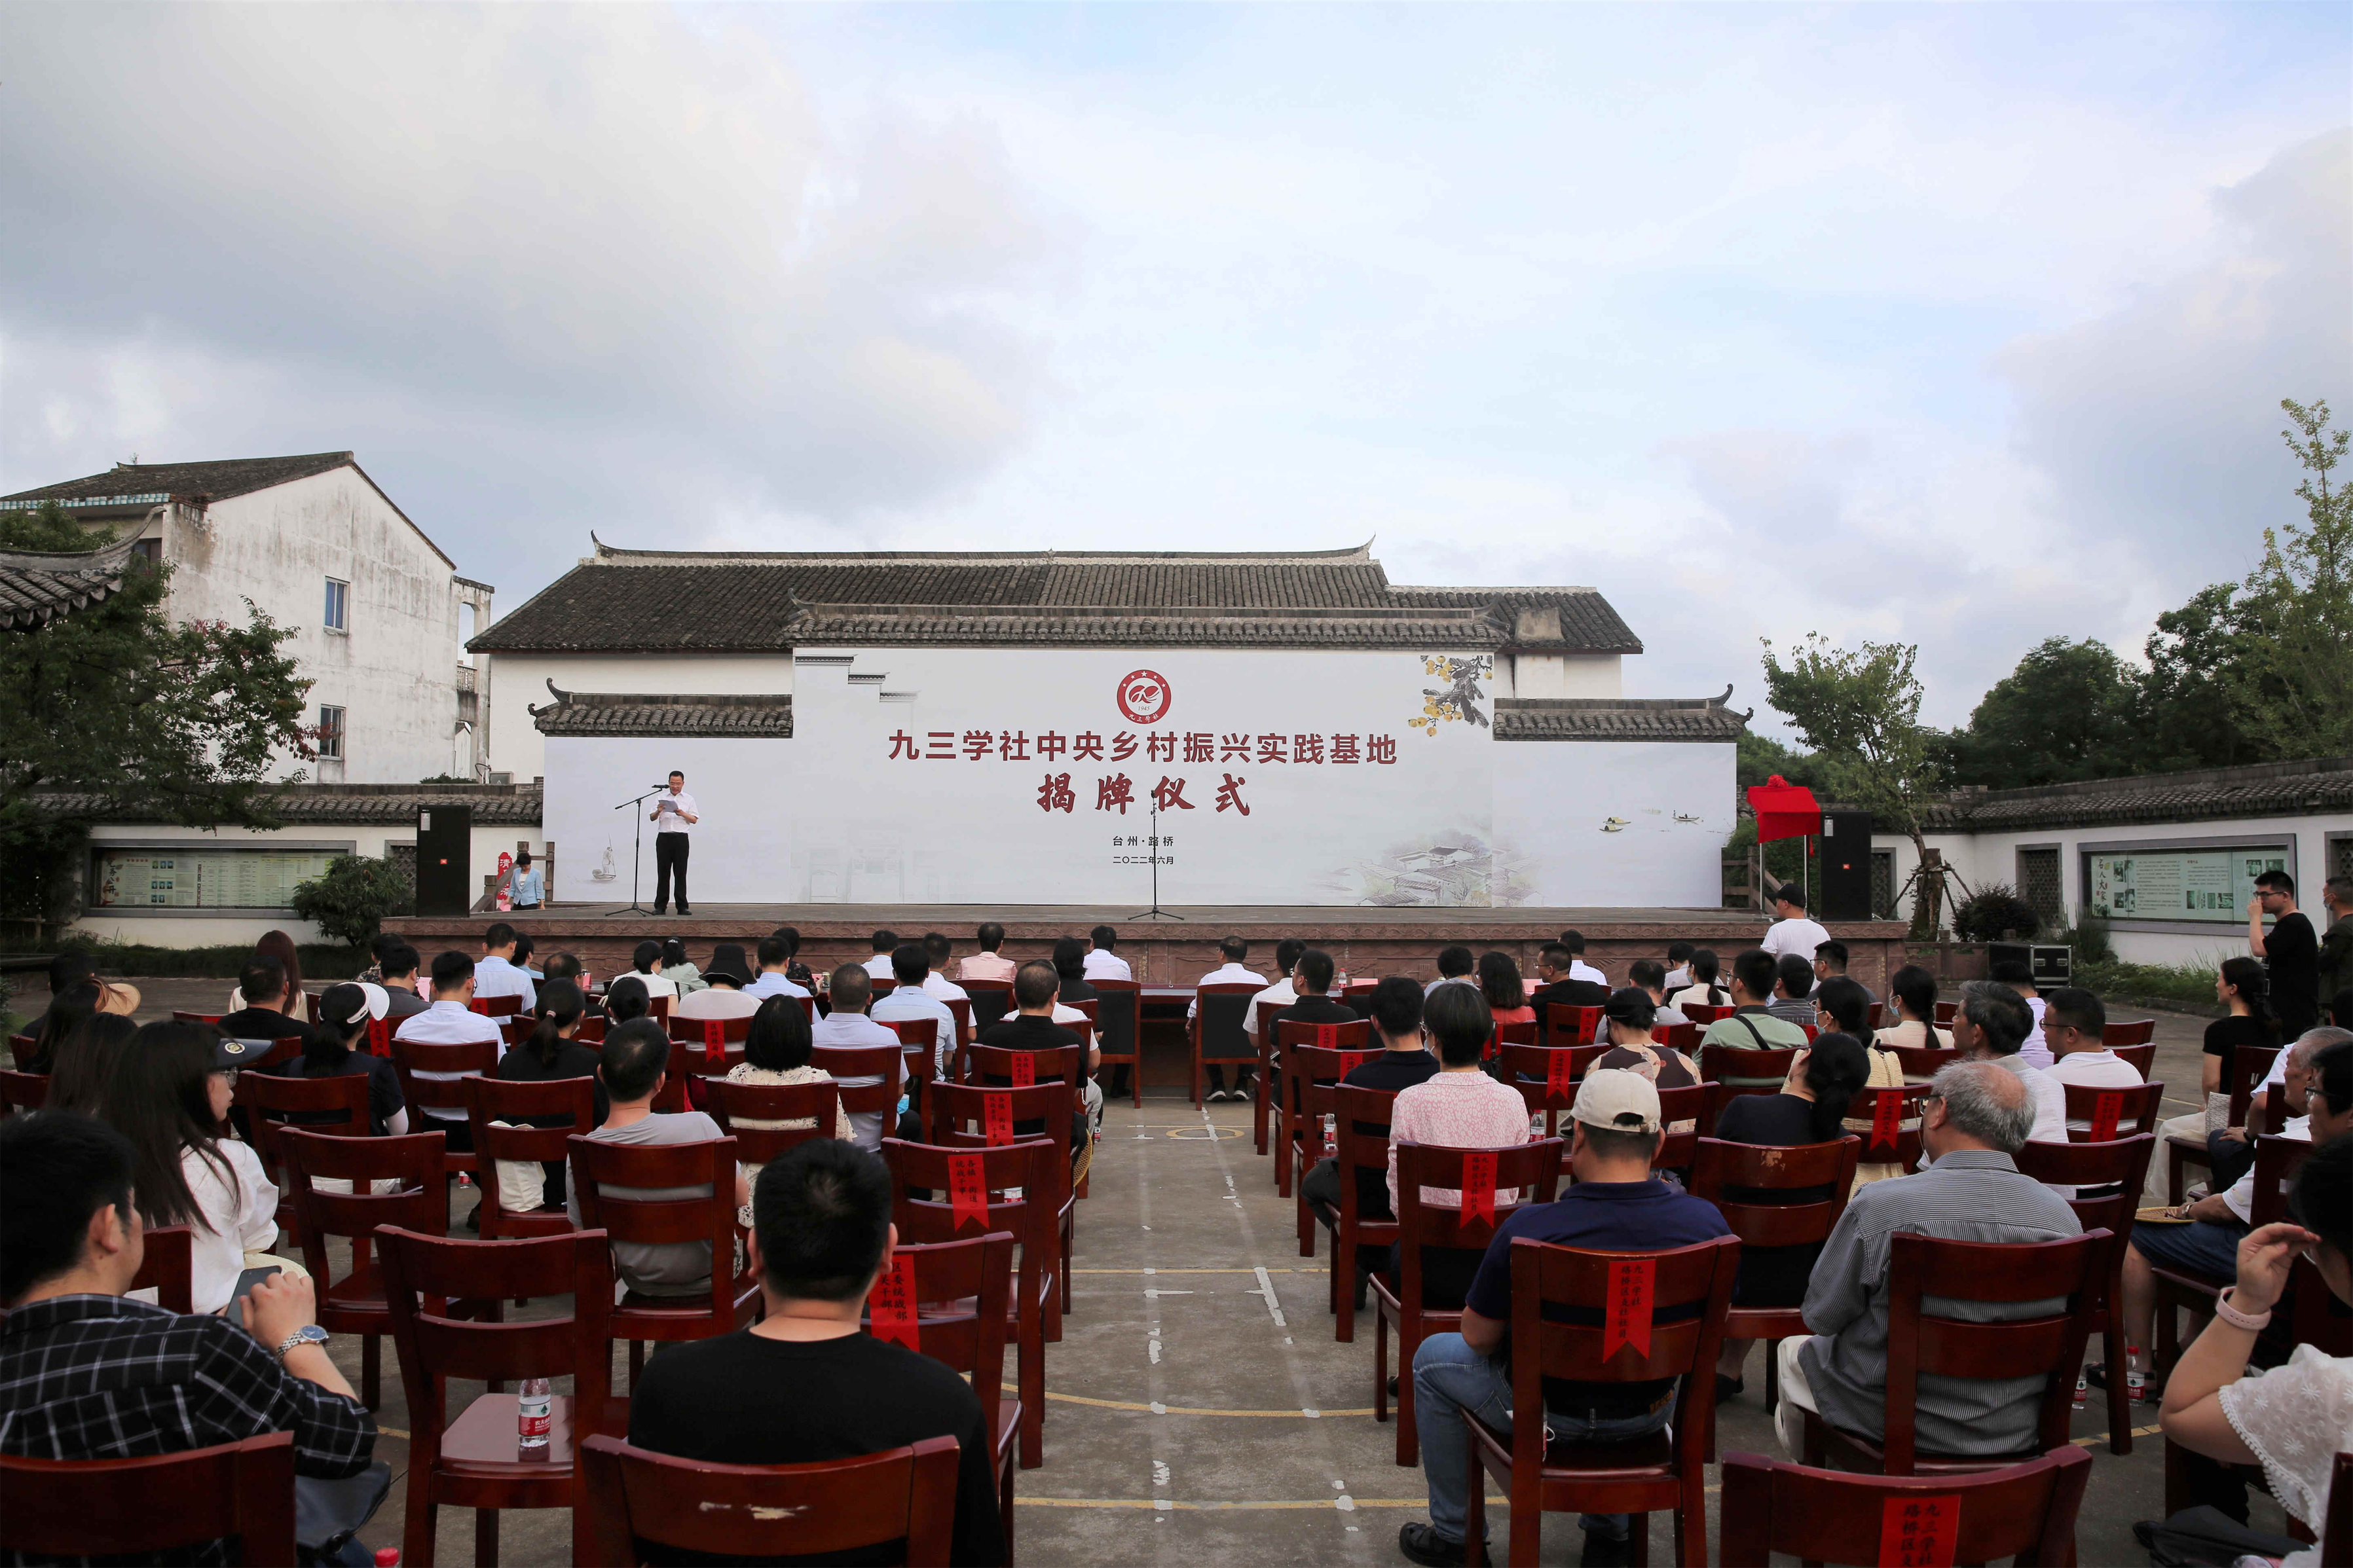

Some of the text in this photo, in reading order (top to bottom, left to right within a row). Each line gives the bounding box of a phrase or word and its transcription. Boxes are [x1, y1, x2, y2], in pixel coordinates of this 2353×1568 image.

[888, 729, 1398, 765] 九三学社中央乡村振兴实践基地
[1038, 773, 1250, 816] 揭牌仪式
[1113, 835, 1174, 847] 台州·路桥
[1480, 1156, 1489, 1187] 九三学社
[892, 1262, 908, 1322] 区委统战部
[1633, 1264, 1644, 1307] 九三学社
[1918, 1502, 1941, 1566] 九三学社
